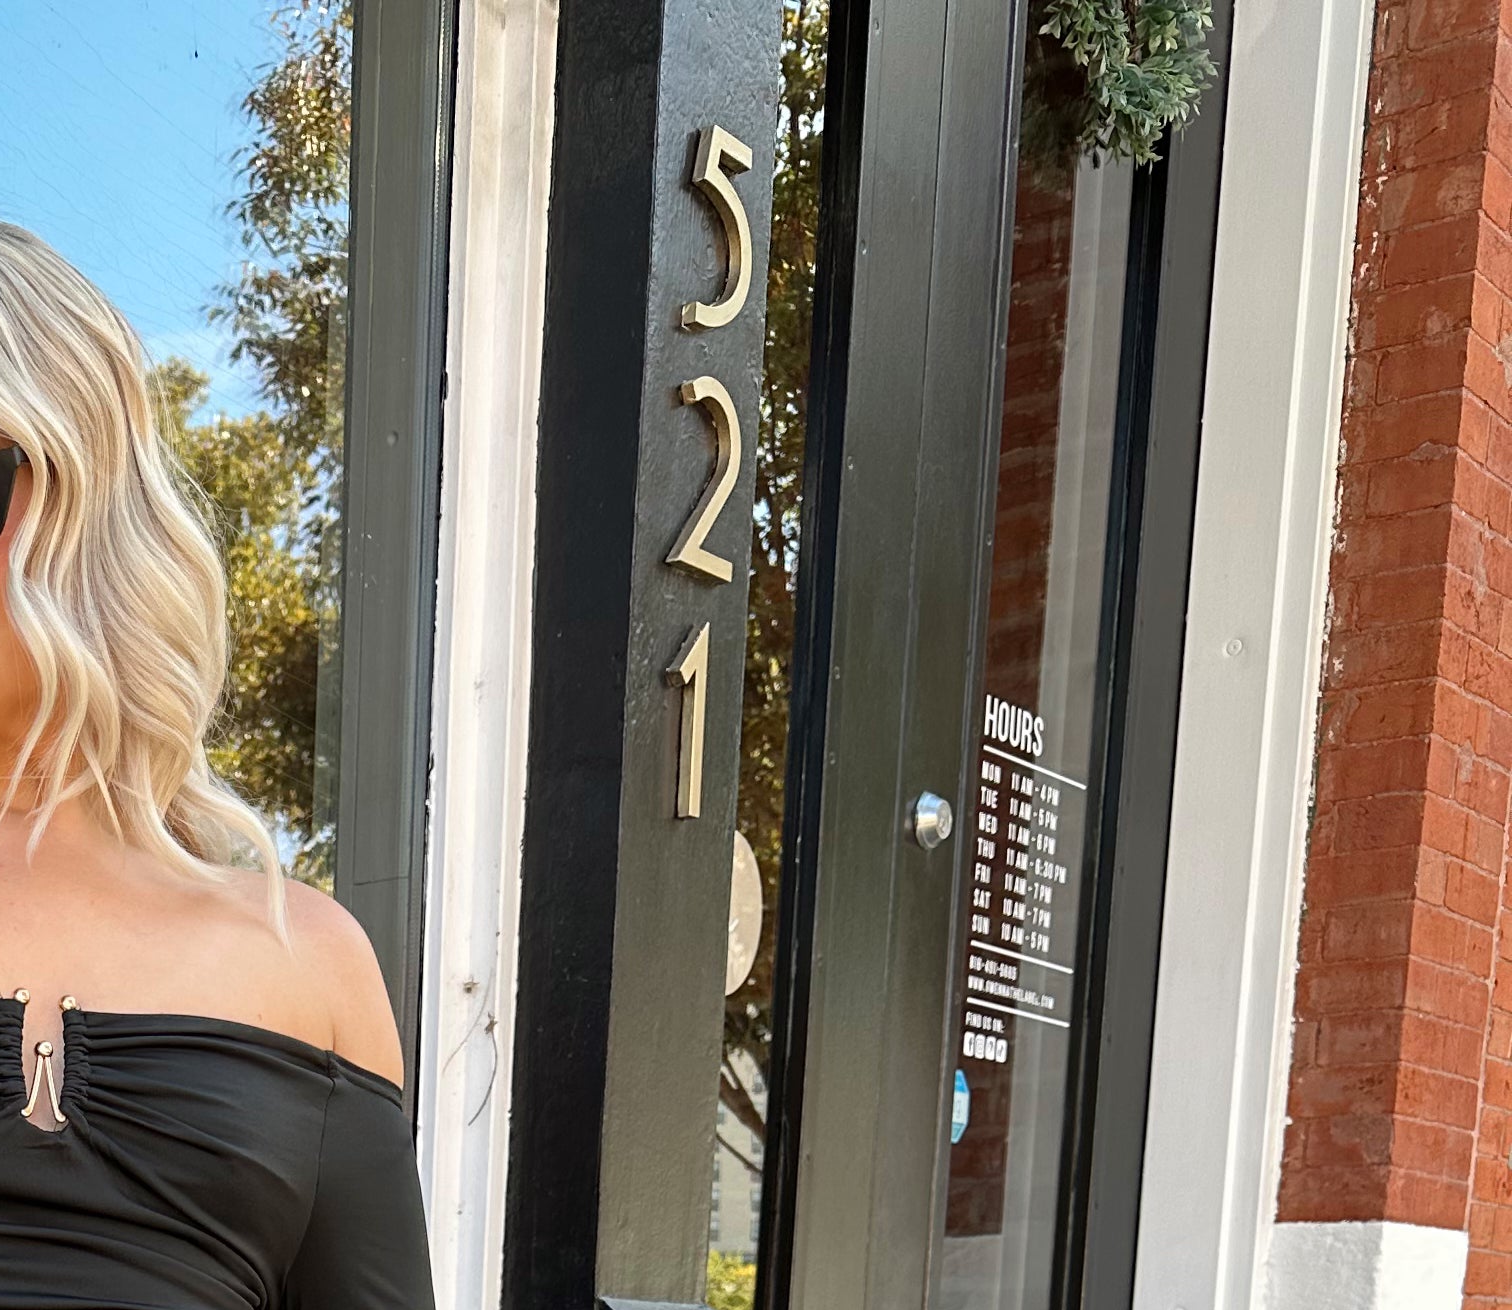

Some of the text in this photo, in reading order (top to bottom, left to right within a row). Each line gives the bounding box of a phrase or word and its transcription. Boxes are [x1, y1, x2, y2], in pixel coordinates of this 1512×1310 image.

[984, 694, 1044, 757] HOURS
[981, 786, 998, 808] TUE
[1019, 802, 1032, 820] AM
[1045, 811, 1058, 831] PM
[1021, 777, 1033, 796] AM
[1047, 787, 1060, 806] PM
[979, 812, 997, 834] WED
[1017, 826, 1030, 845] AM
[1043, 836, 1056, 855] PM
[978, 838, 994, 859] THU
[1015, 852, 1028, 870] AM
[1054, 865, 1066, 883] PM
[975, 863, 990, 883] FRI
[1014, 877, 1027, 895] AM
[1039, 885, 1052, 904] PM
[974, 888, 991, 908] SAT
[1013, 902, 1026, 920] AM
[1038, 909, 1051, 928] PM
[1011, 926, 1024, 945] AM
[1037, 934, 1049, 952] PM
